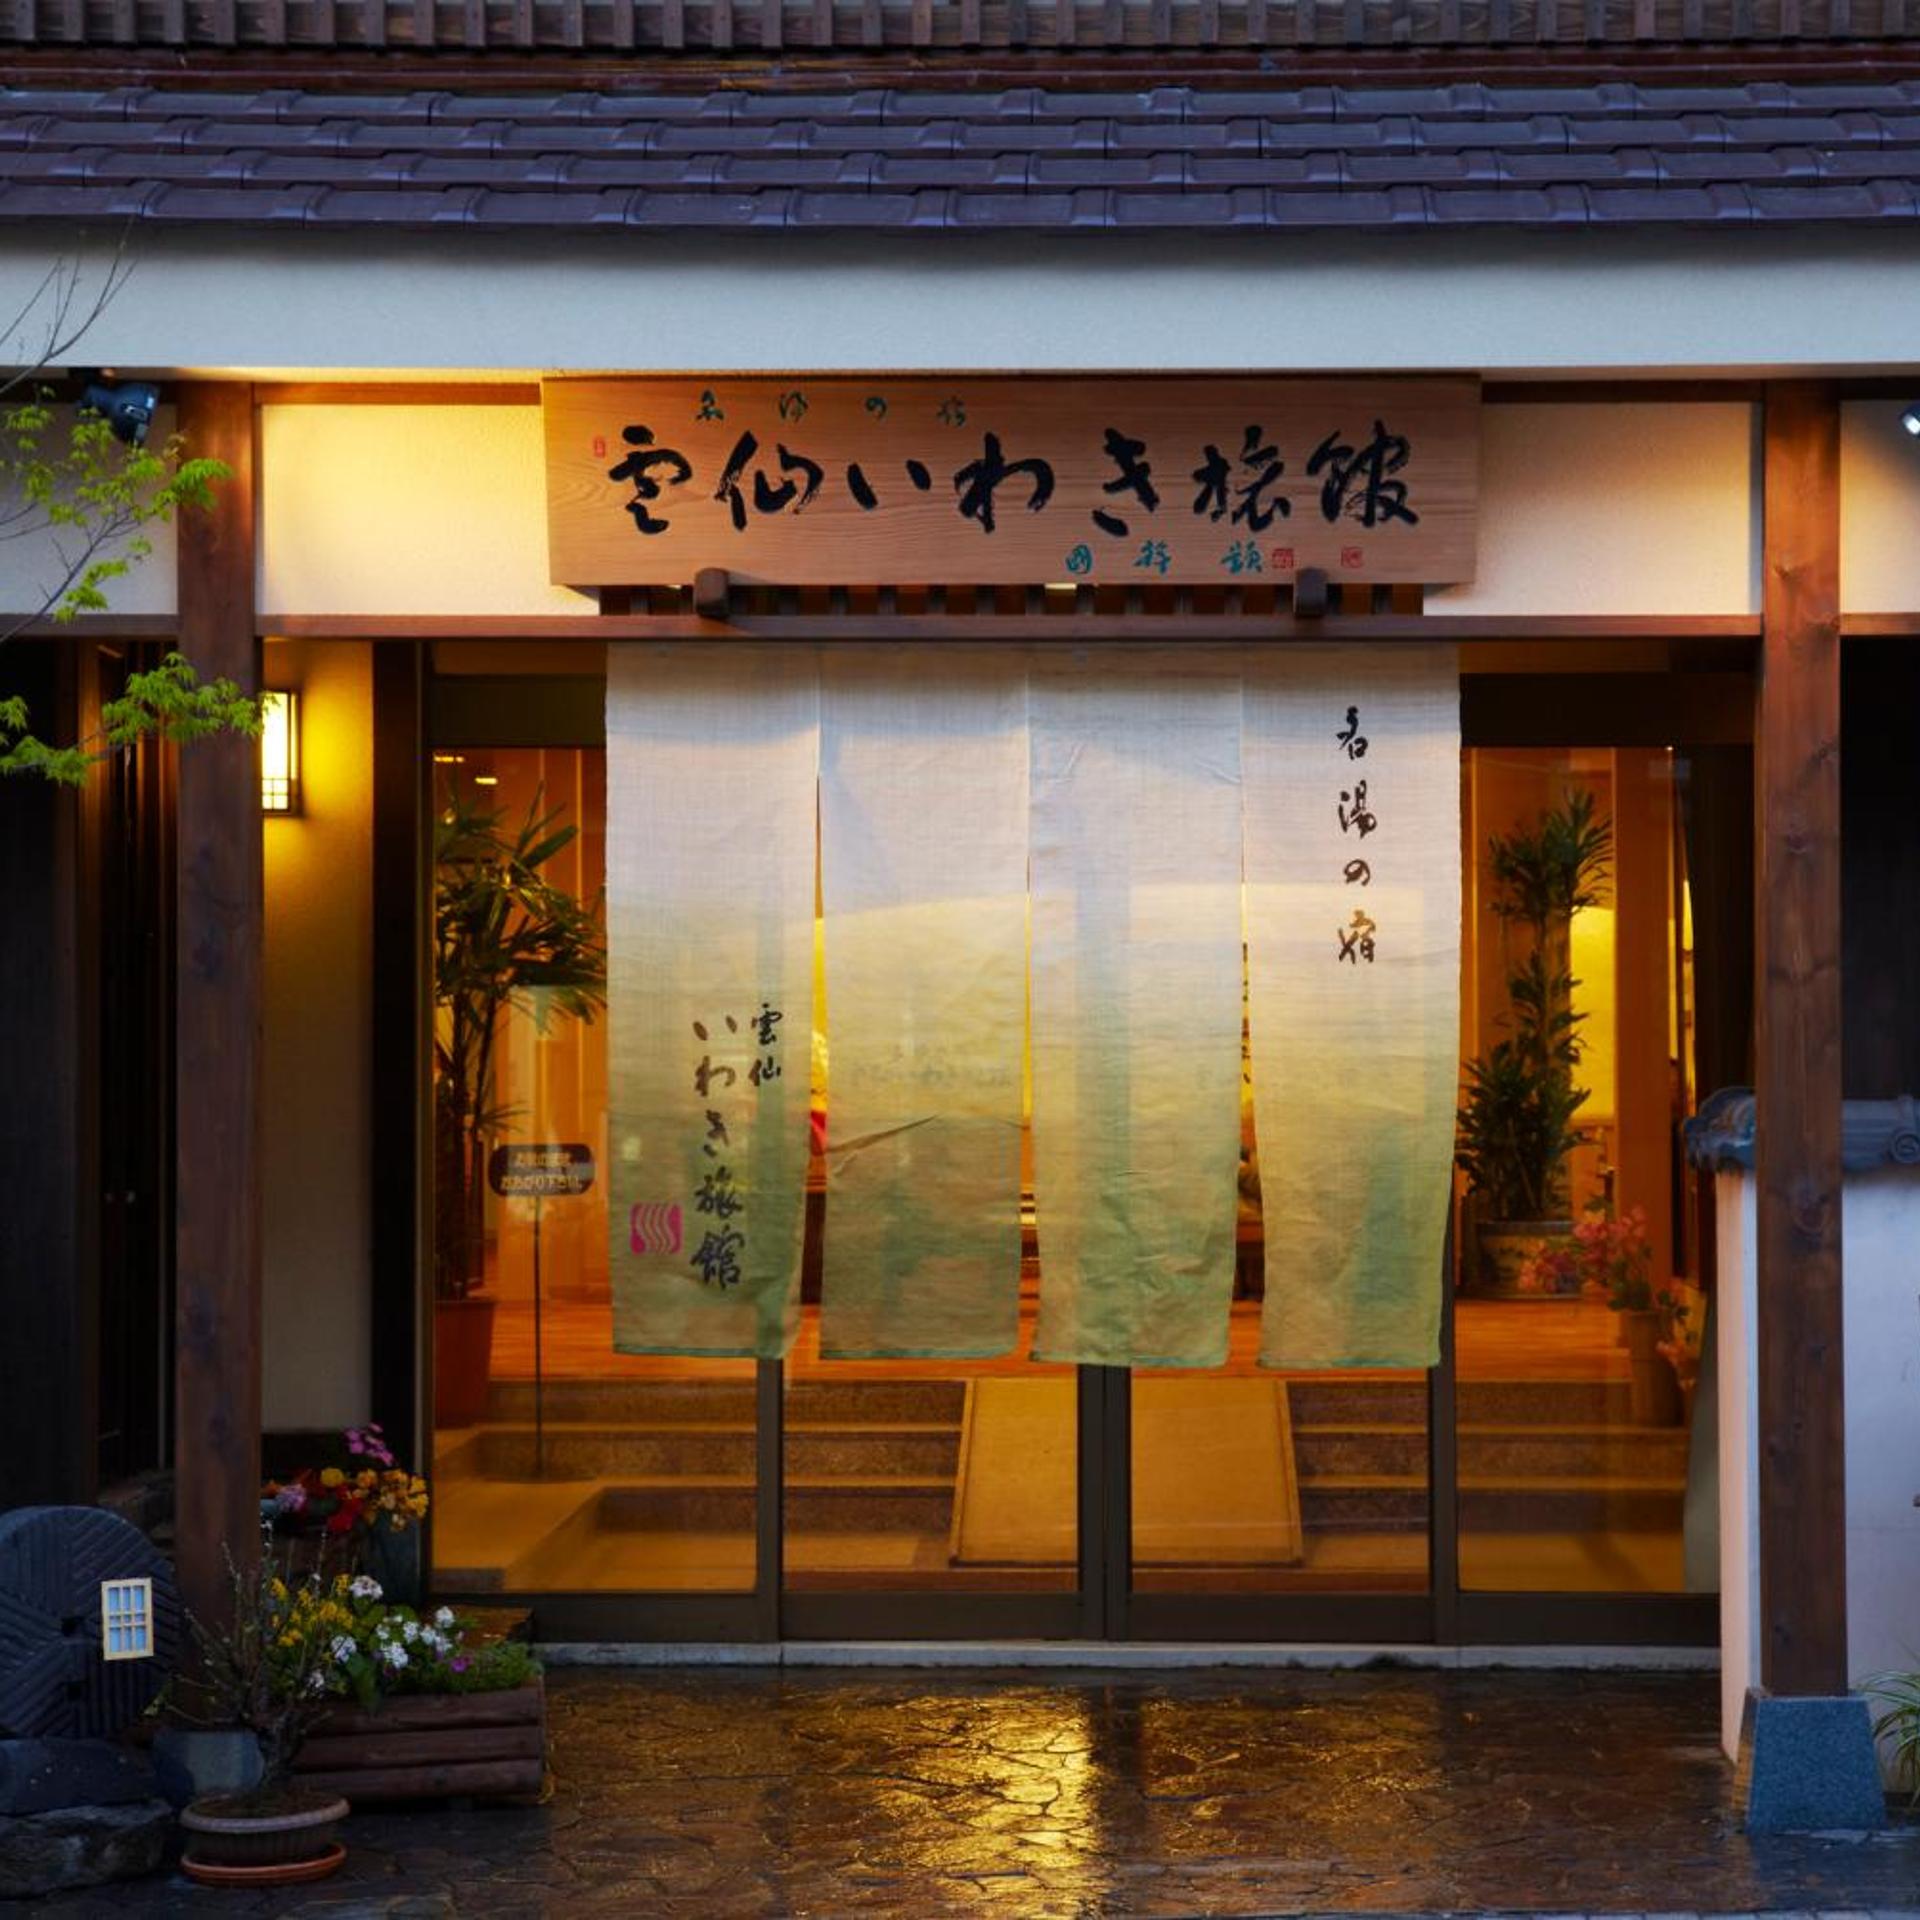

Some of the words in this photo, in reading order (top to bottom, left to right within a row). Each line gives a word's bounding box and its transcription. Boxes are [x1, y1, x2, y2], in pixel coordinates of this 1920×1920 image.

[608, 419, 1420, 538] 雲仙いわき旅館
[1336, 705, 1378, 965] 名湯の宿
[748, 1002, 784, 1088] 雲仙
[689, 1014, 745, 1291] いわき旅館
